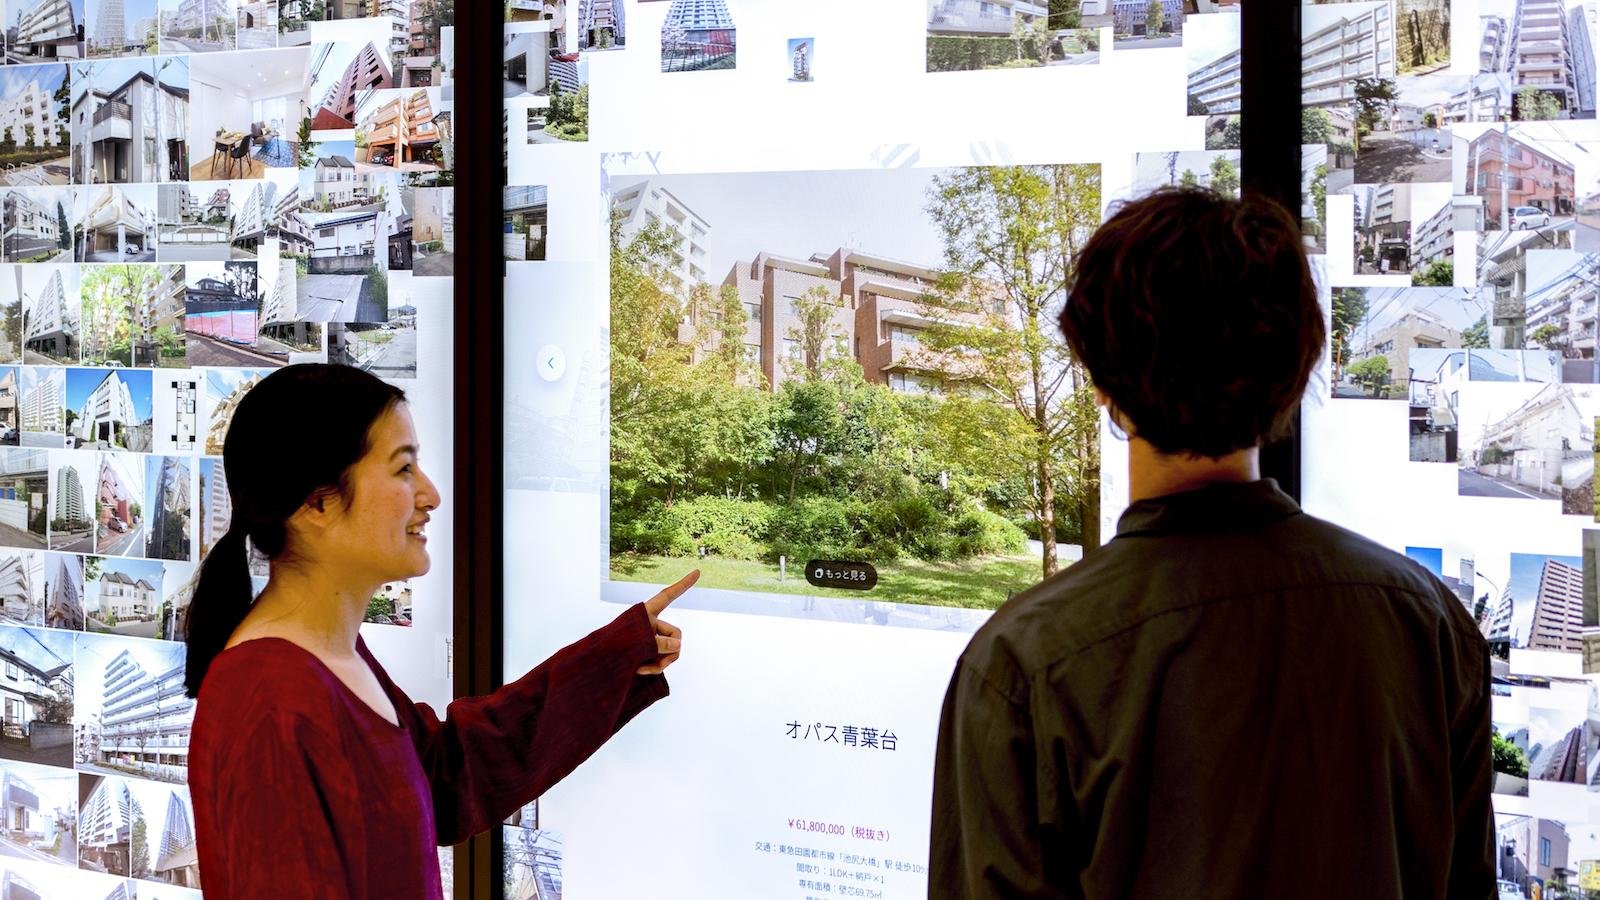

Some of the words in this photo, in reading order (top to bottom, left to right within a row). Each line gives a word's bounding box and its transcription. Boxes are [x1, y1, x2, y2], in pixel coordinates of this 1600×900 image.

[825, 569, 867, 581] もっと見る
[786, 720, 898, 751] オパス青葉台
